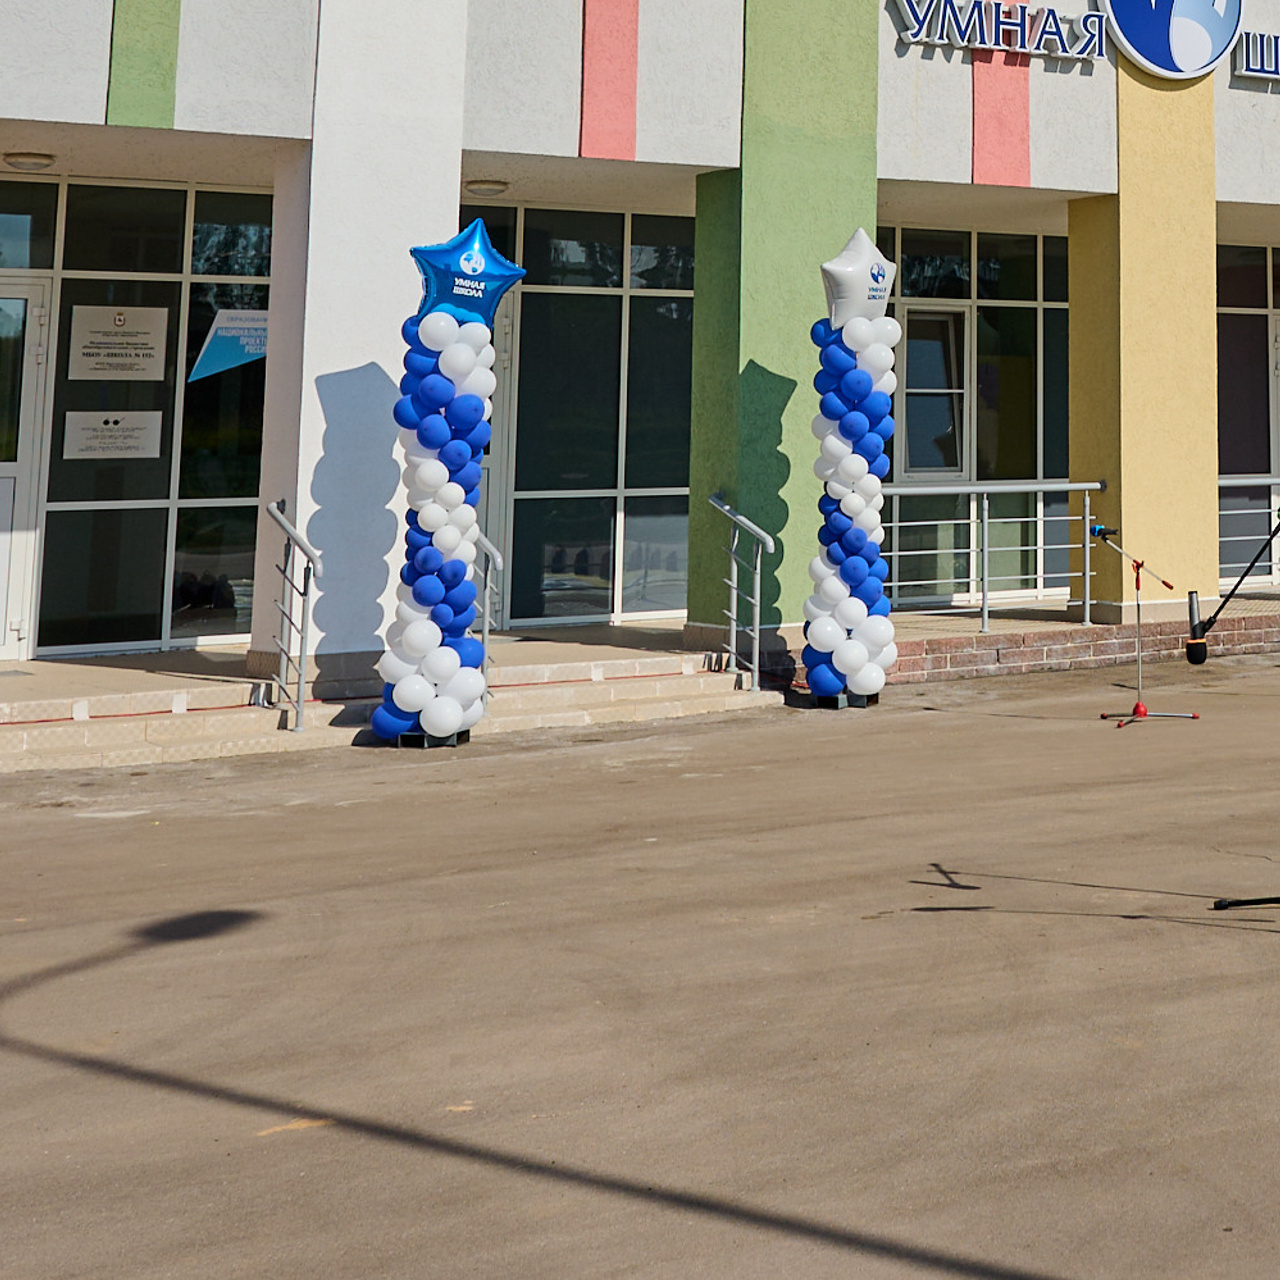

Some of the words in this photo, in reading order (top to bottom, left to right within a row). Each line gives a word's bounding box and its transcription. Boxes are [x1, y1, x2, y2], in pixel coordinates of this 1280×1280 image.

[454, 277, 486, 290] УМНАЯ
[452, 286, 483, 299] ШКОЛА
[226, 315, 268, 323] ОБРАЗОВАНИ
[217, 327, 268, 337] НАЦИОНАЛЬНЫ
[244, 345, 267, 354] РОССИ
